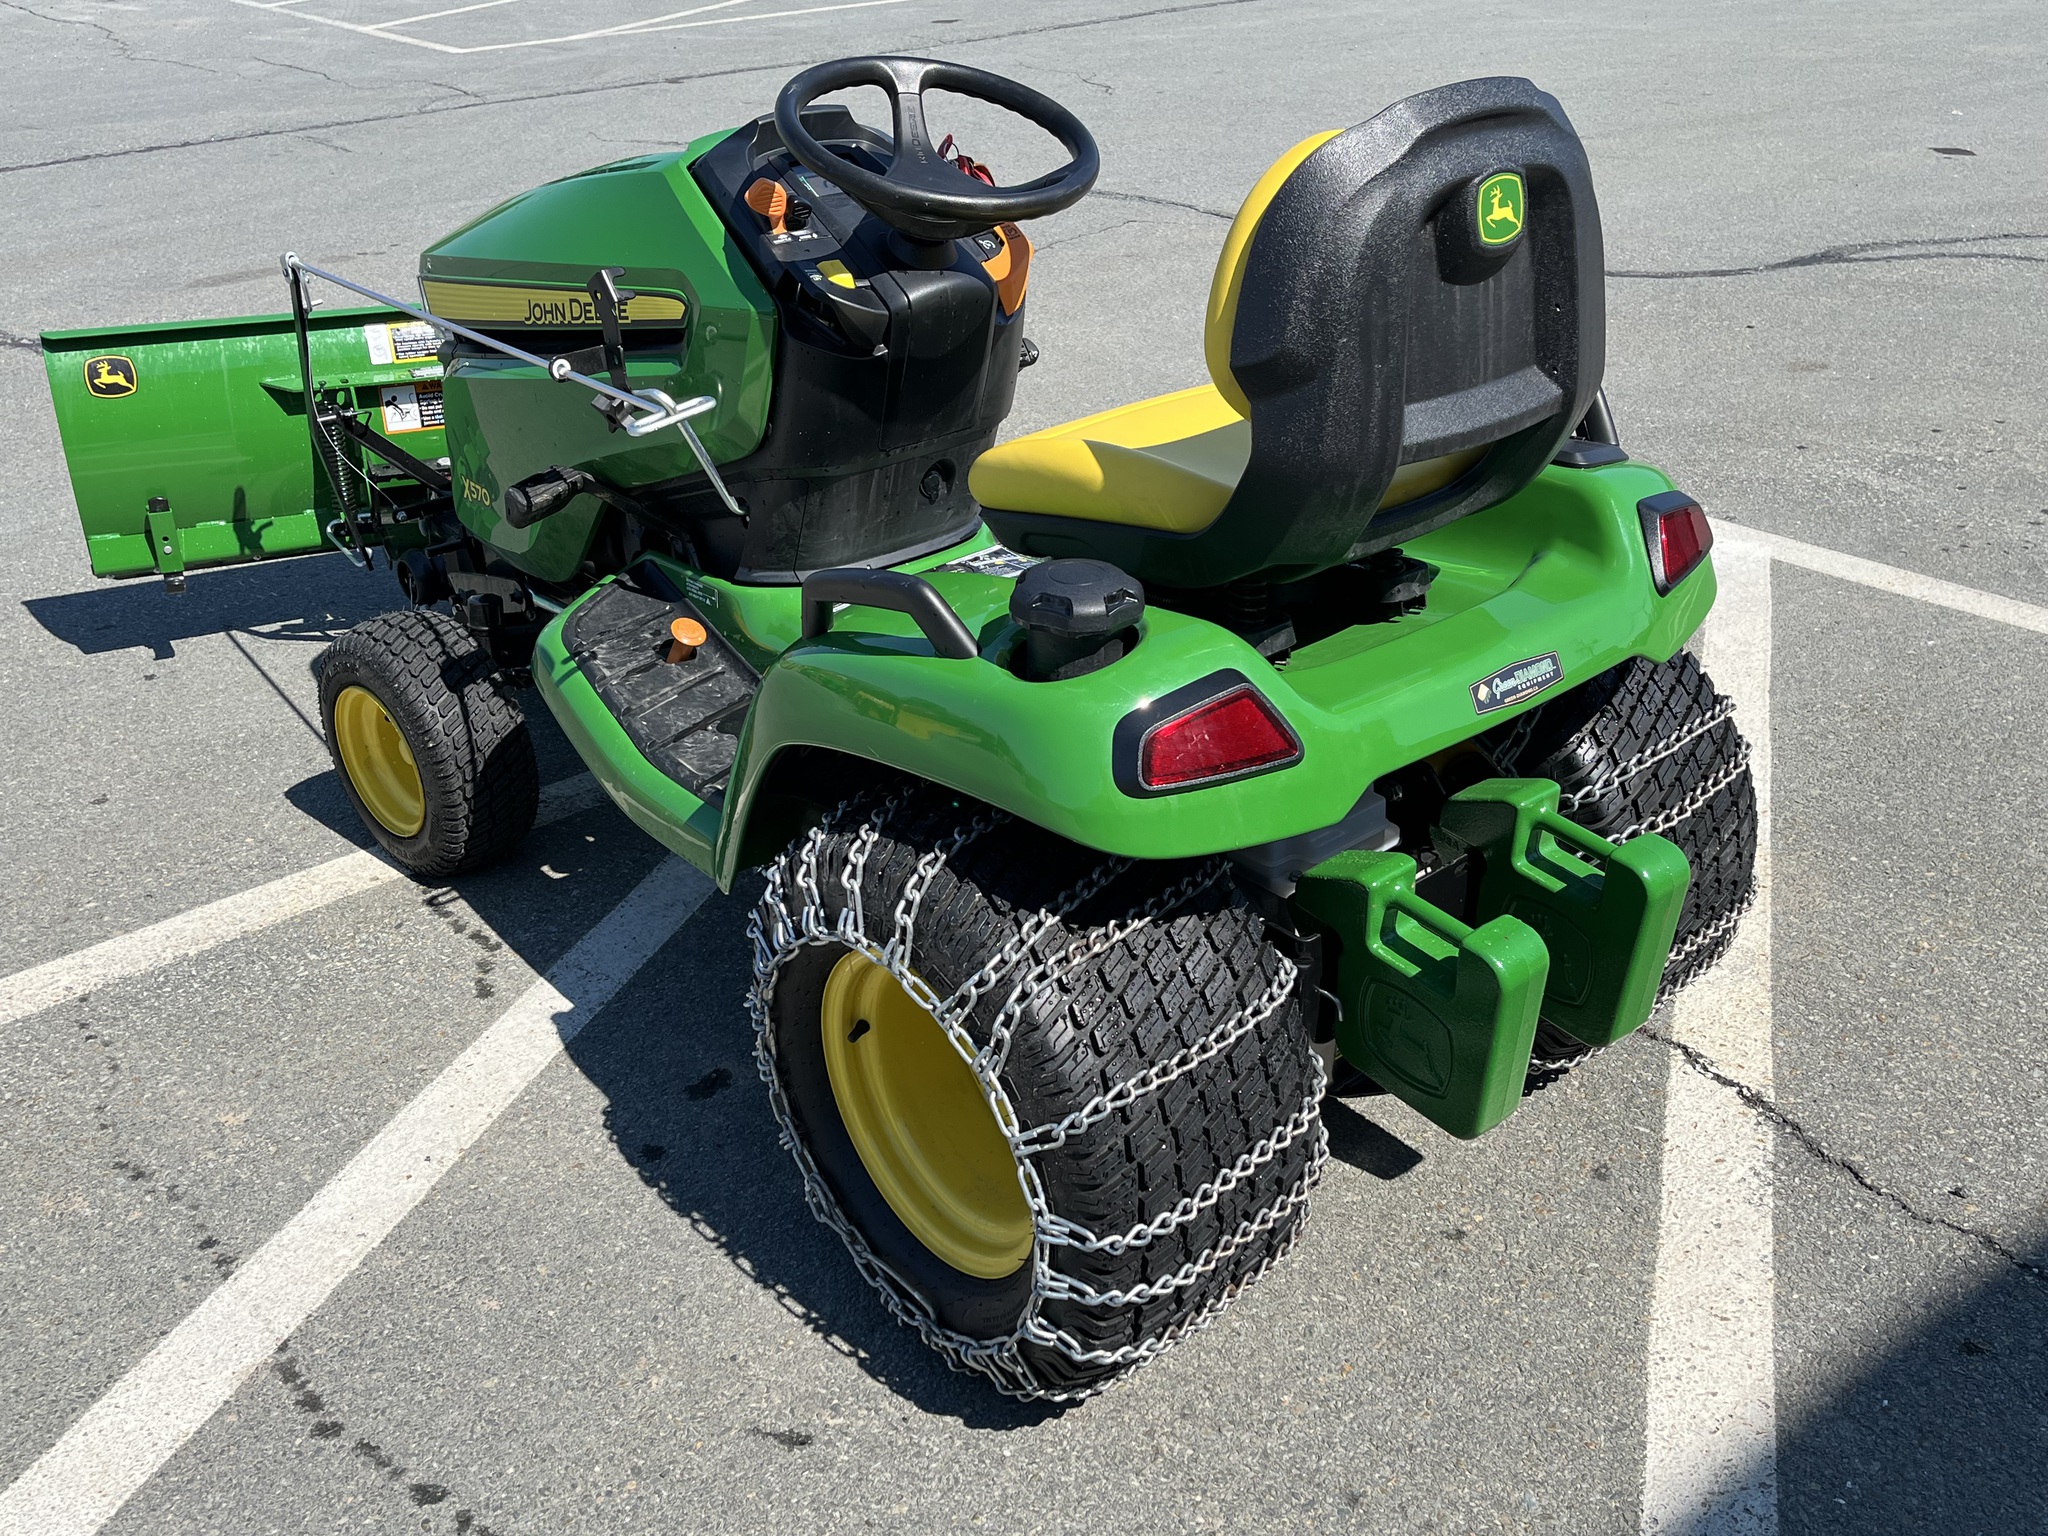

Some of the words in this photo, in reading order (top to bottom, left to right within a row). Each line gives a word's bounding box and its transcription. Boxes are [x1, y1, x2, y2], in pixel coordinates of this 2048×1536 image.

[524, 298, 567, 324] JOHN
[568, 298, 631, 323] DEE
[461, 475, 490, 506] X570
[1517, 671, 1554, 690] EQUIPMENT
